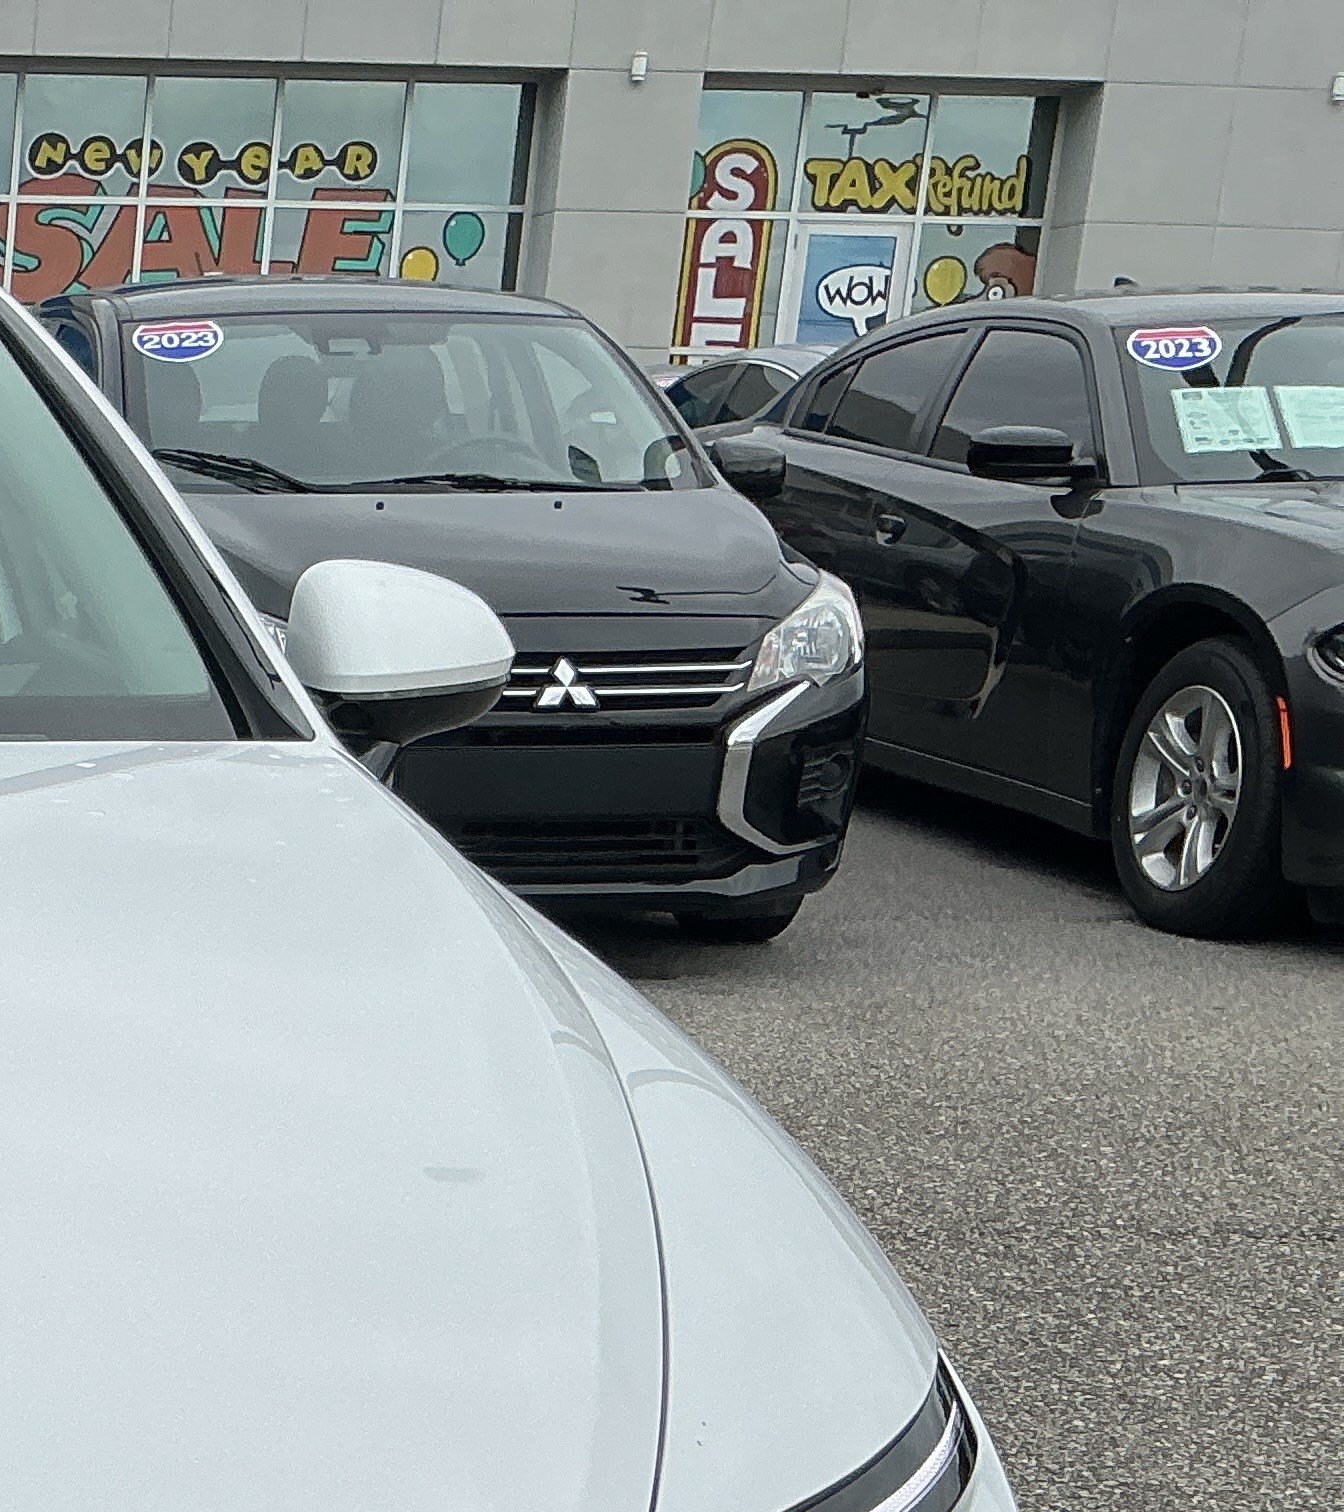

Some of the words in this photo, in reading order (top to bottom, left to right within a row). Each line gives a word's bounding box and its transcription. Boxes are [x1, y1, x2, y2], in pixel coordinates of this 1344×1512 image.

[806, 156, 916, 209] TAX
[915, 155, 1028, 235] Refund
[688, 152, 761, 364] SALE
[823, 275, 891, 306] WOW
[141, 331, 216, 349] 2023
[1141, 338, 1212, 359] 2023
